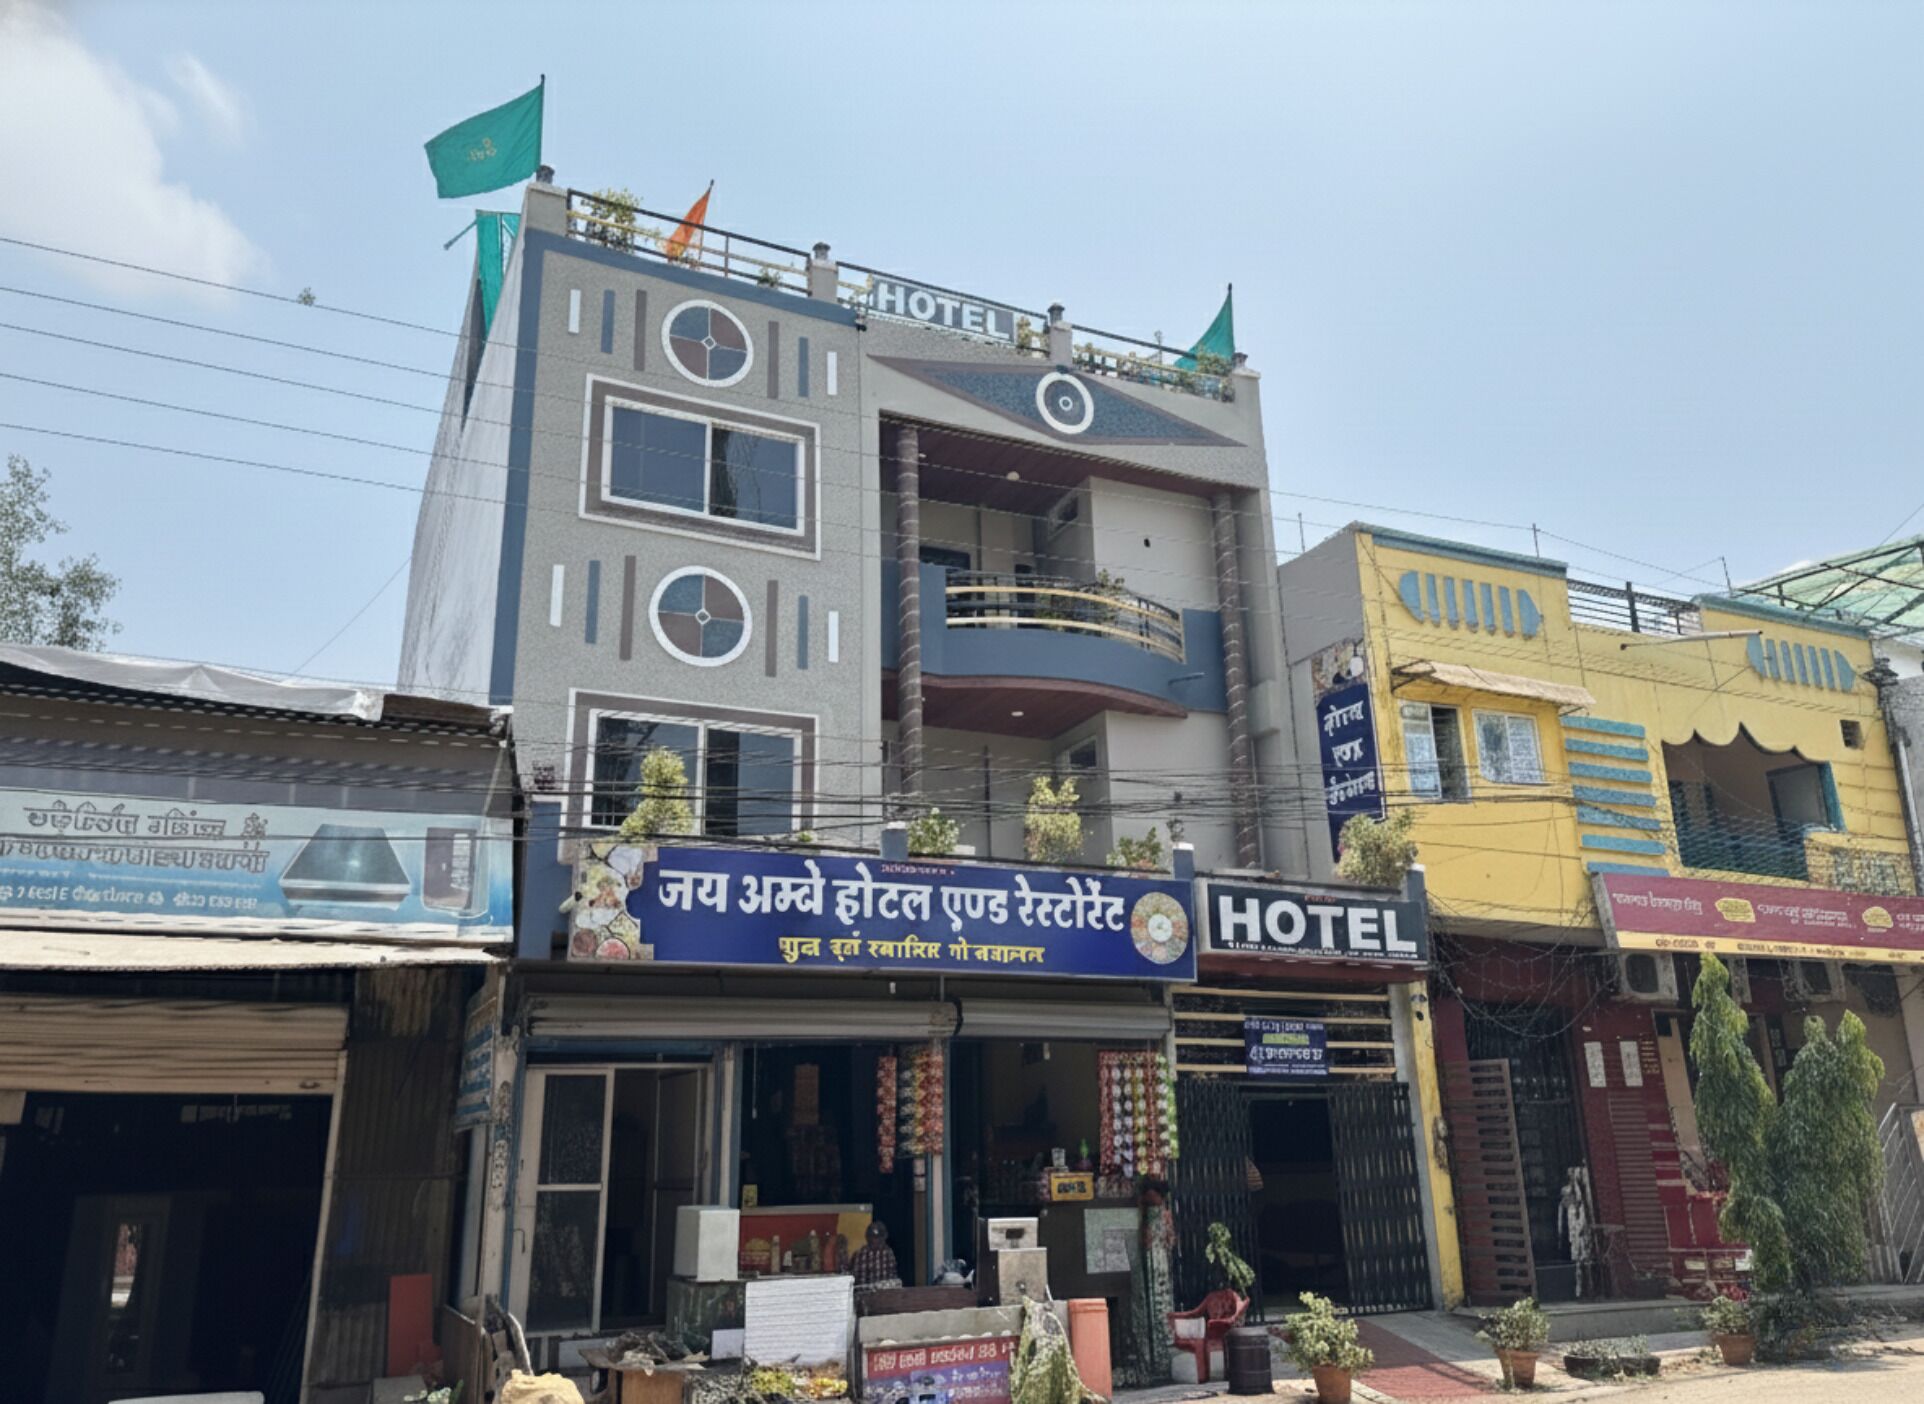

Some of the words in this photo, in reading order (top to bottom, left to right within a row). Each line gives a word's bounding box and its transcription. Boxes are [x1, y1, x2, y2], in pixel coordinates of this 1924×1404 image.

[877, 281, 1010, 340] HOTEL
[659, 869, 730, 913] जय
[832, 861, 933, 926] होटल
[940, 885, 1009, 932] एण्ड
[1218, 895, 1418, 953] HOTEL
